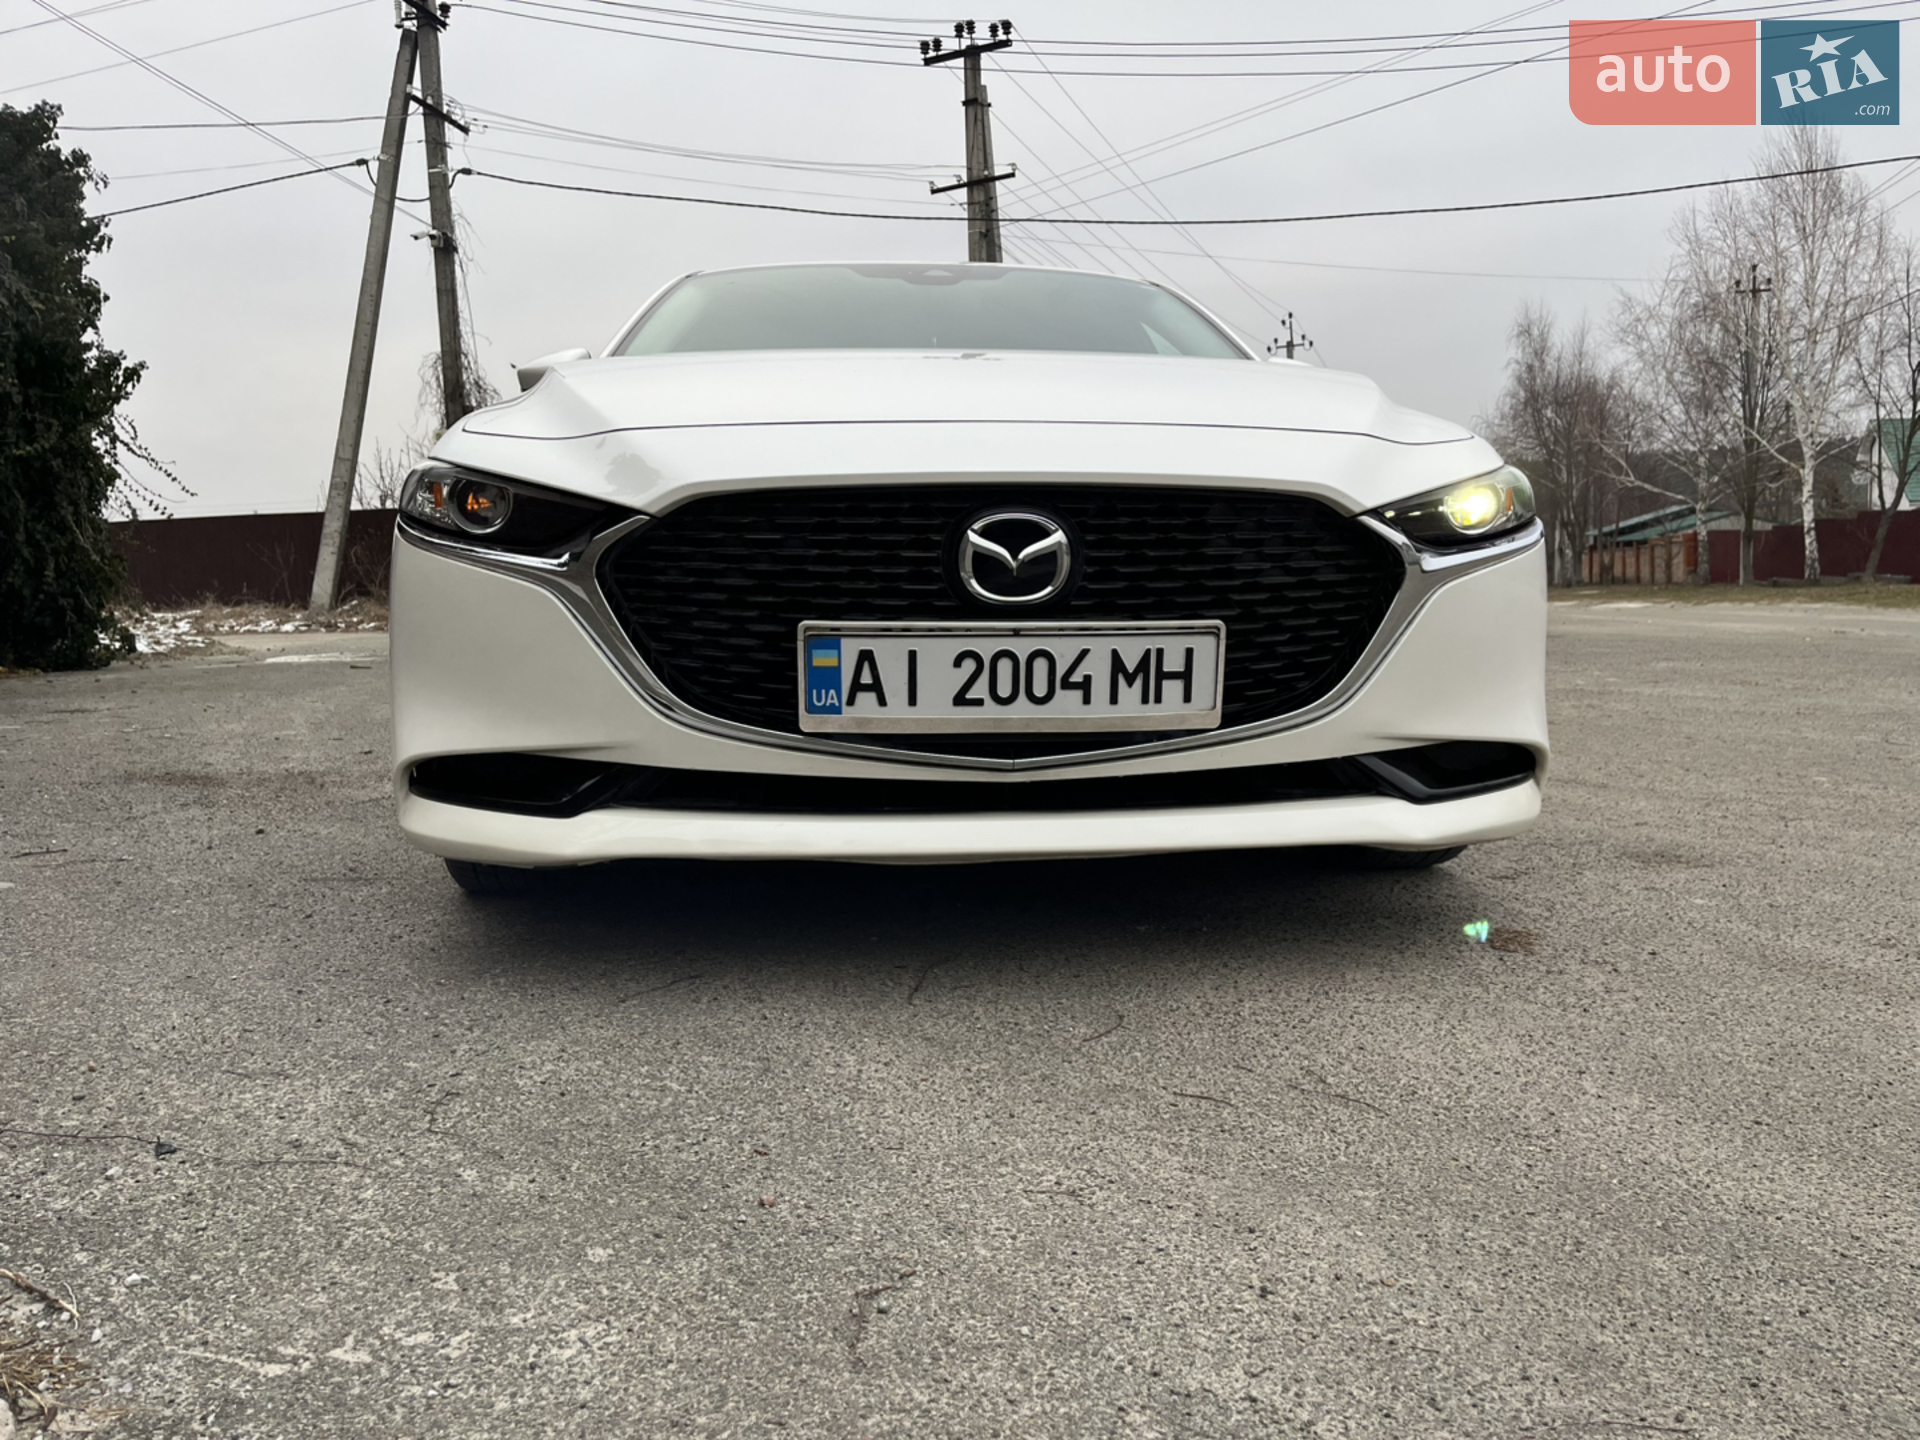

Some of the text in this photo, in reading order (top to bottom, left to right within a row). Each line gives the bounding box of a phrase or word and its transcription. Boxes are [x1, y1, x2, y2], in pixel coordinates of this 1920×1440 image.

[952, 648, 1092, 707] 2004
[1109, 646, 1194, 706] MH
[813, 689, 839, 707] UA
